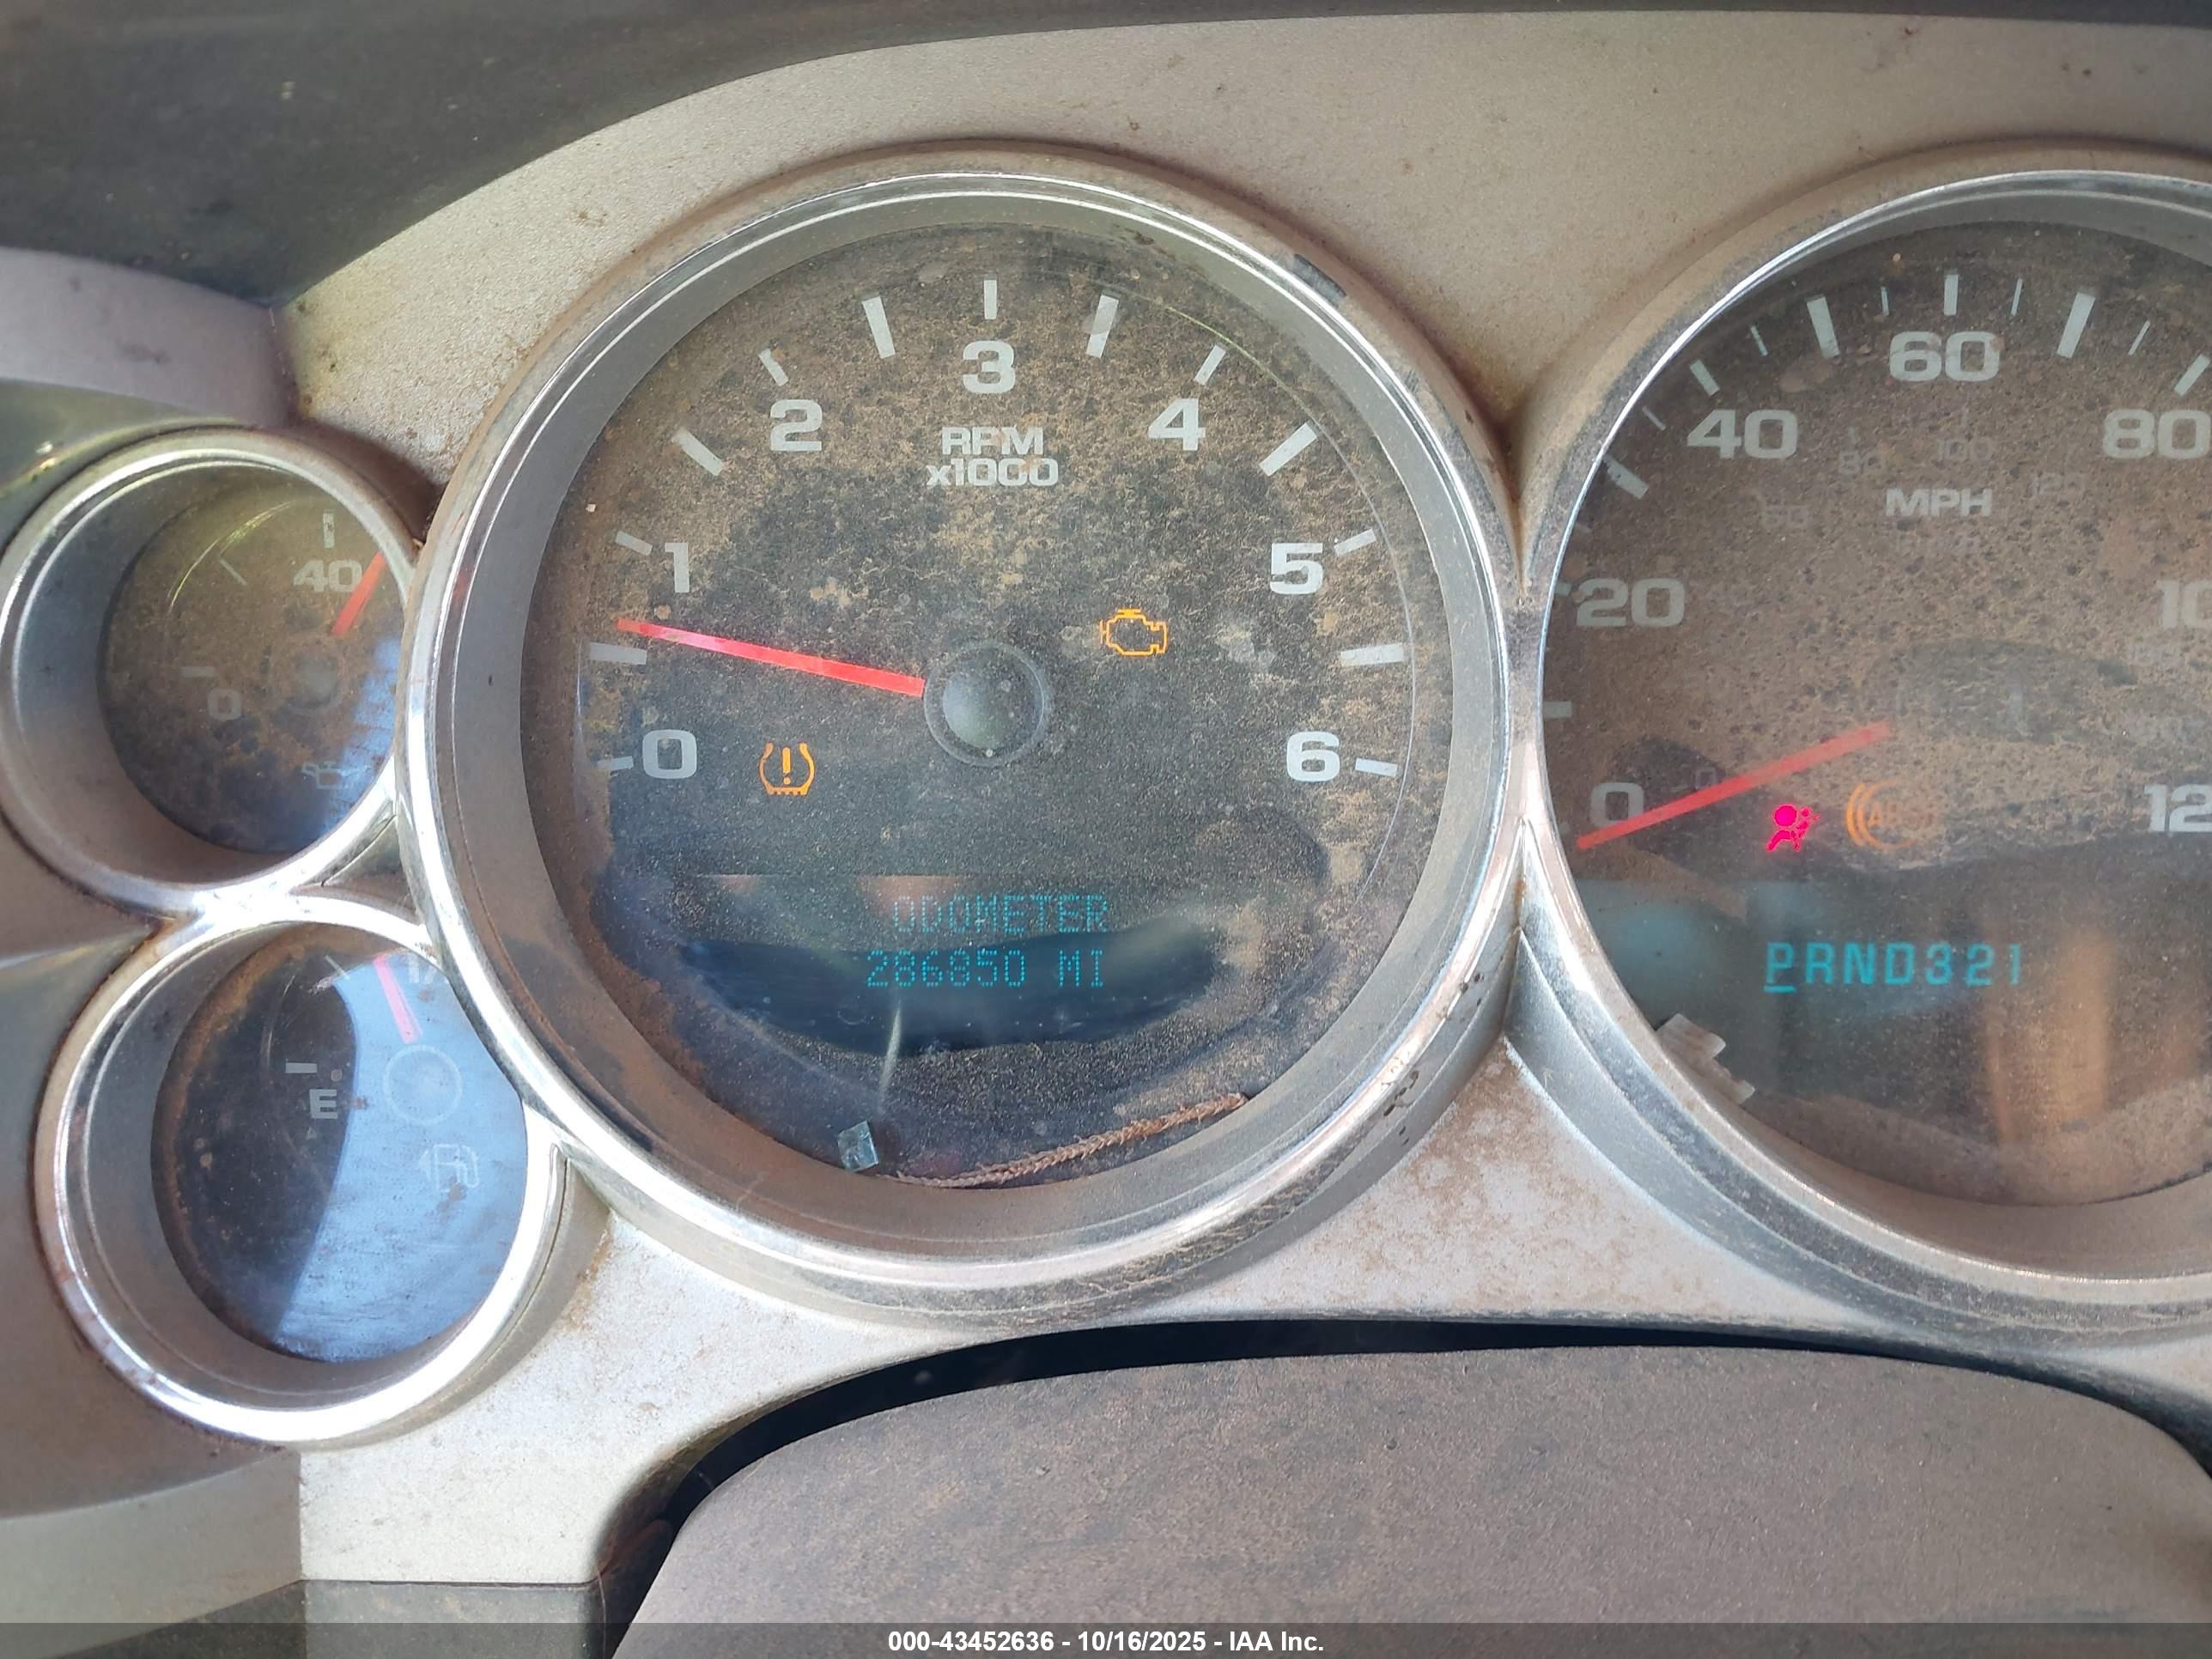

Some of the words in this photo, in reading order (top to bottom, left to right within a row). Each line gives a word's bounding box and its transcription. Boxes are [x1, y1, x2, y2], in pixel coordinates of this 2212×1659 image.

[963, 341, 1016, 393] 3
[1889, 331, 2001, 381] 60
[770, 399, 823, 452] 2
[942, 427, 1044, 455] RPM
[1148, 398, 1206, 451] 4
[1687, 410, 1798, 459] 40
[2103, 410, 2212, 459] 80
[927, 458, 1059, 487] x1000
[1886, 488, 1992, 516] MPH
[293, 560, 362, 592] 40
[665, 543, 690, 593] 1
[1270, 543, 1323, 595] 5
[1577, 579, 1686, 628] 20
[208, 689, 241, 720] 0
[642, 729, 697, 780] 0
[1286, 731, 1340, 782] 6
[1590, 782, 1644, 829] 0
[893, 894, 1108, 934] ODOMETER
[866, 948, 1026, 988] 286850
[1057, 948, 1104, 988] MI
[1765, 941, 2021, 986] PRND321
[309, 1088, 338, 1119] E
